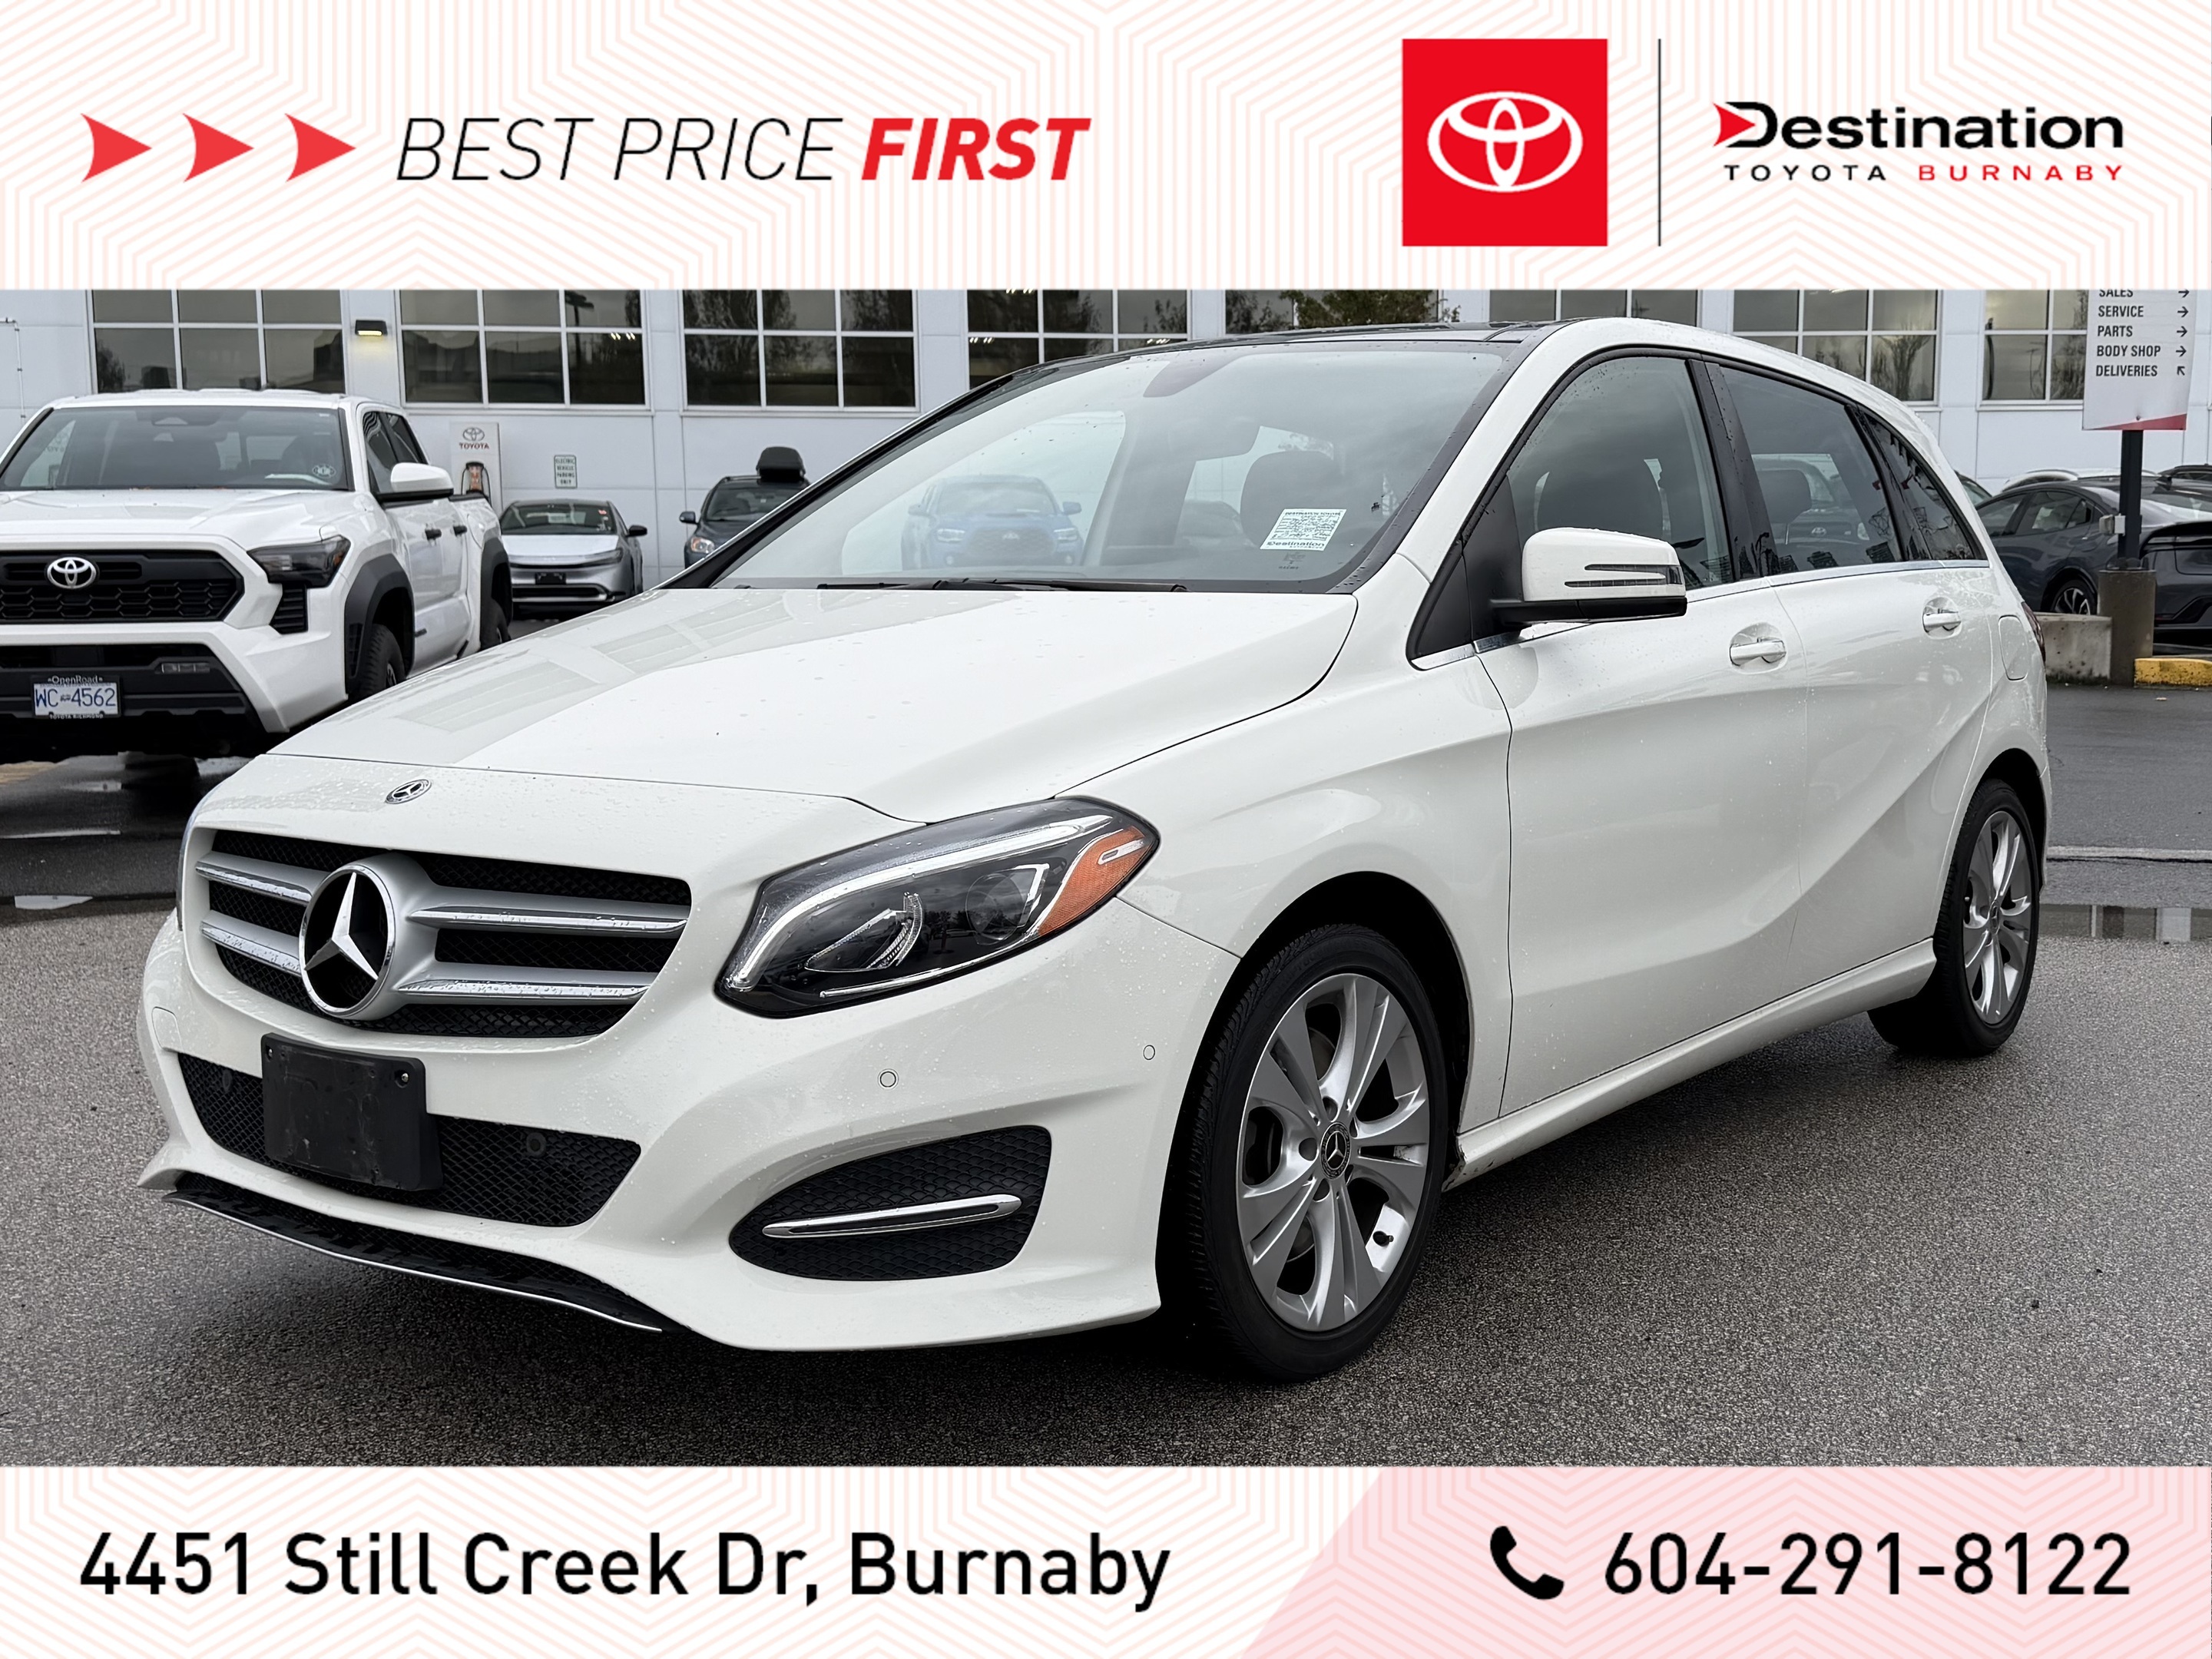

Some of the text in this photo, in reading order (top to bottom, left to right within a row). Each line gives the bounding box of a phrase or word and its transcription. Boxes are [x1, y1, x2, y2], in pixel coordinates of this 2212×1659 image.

[2099, 290, 2133, 298] SALES
[2098, 306, 2144, 317] SERVICE
[2097, 326, 2133, 337] PARTS
[2096, 345, 2161, 356] BODY SHOP
[2095, 365, 2158, 376] DELIVERIES
[51, 675, 98, 684] OpenRoad
[35, 687, 116, 707] WC 4562
